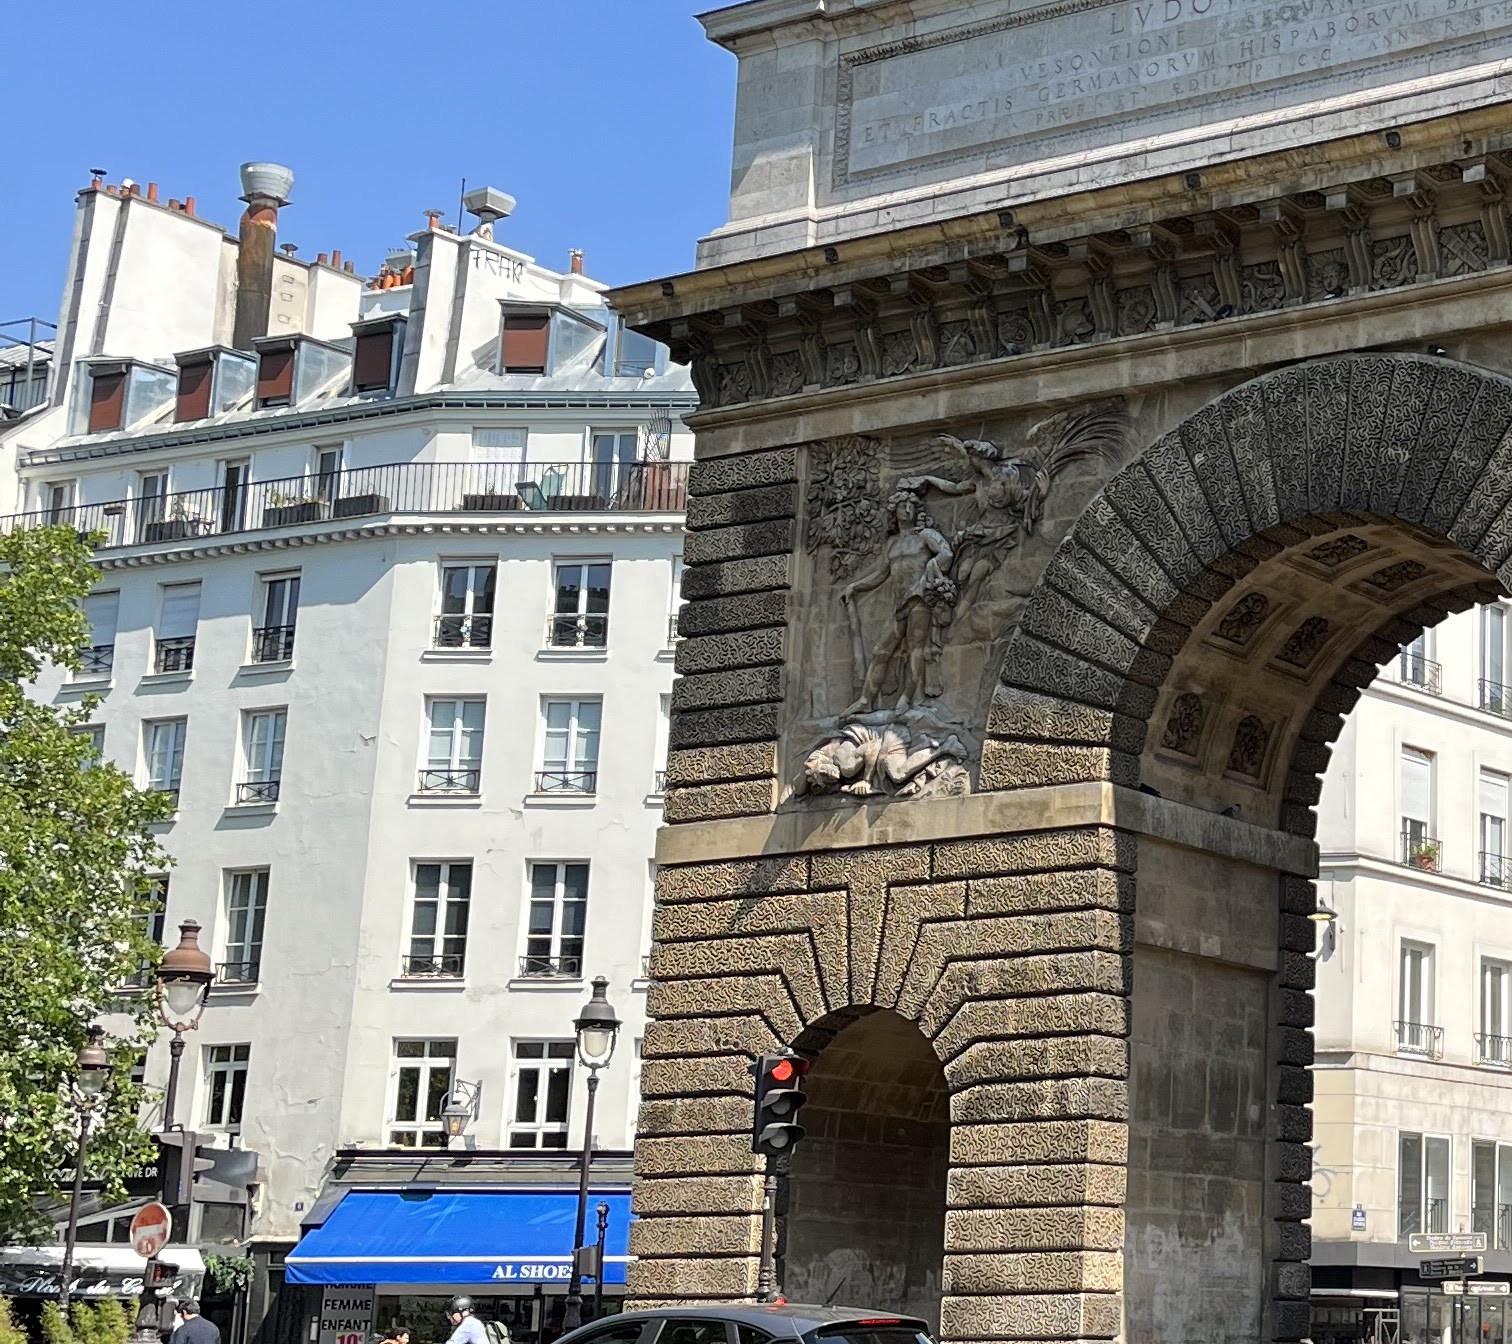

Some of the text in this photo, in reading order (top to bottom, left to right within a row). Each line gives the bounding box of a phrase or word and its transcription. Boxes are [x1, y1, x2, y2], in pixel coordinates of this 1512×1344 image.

[913, 95, 1013, 132] FRACTIS
[1038, 48, 1216, 102] GERMANORVM
[492, 1264, 517, 1279] AL
[324, 1299, 372, 1311] FEMME
[321, 1319, 372, 1331] ENFANT
